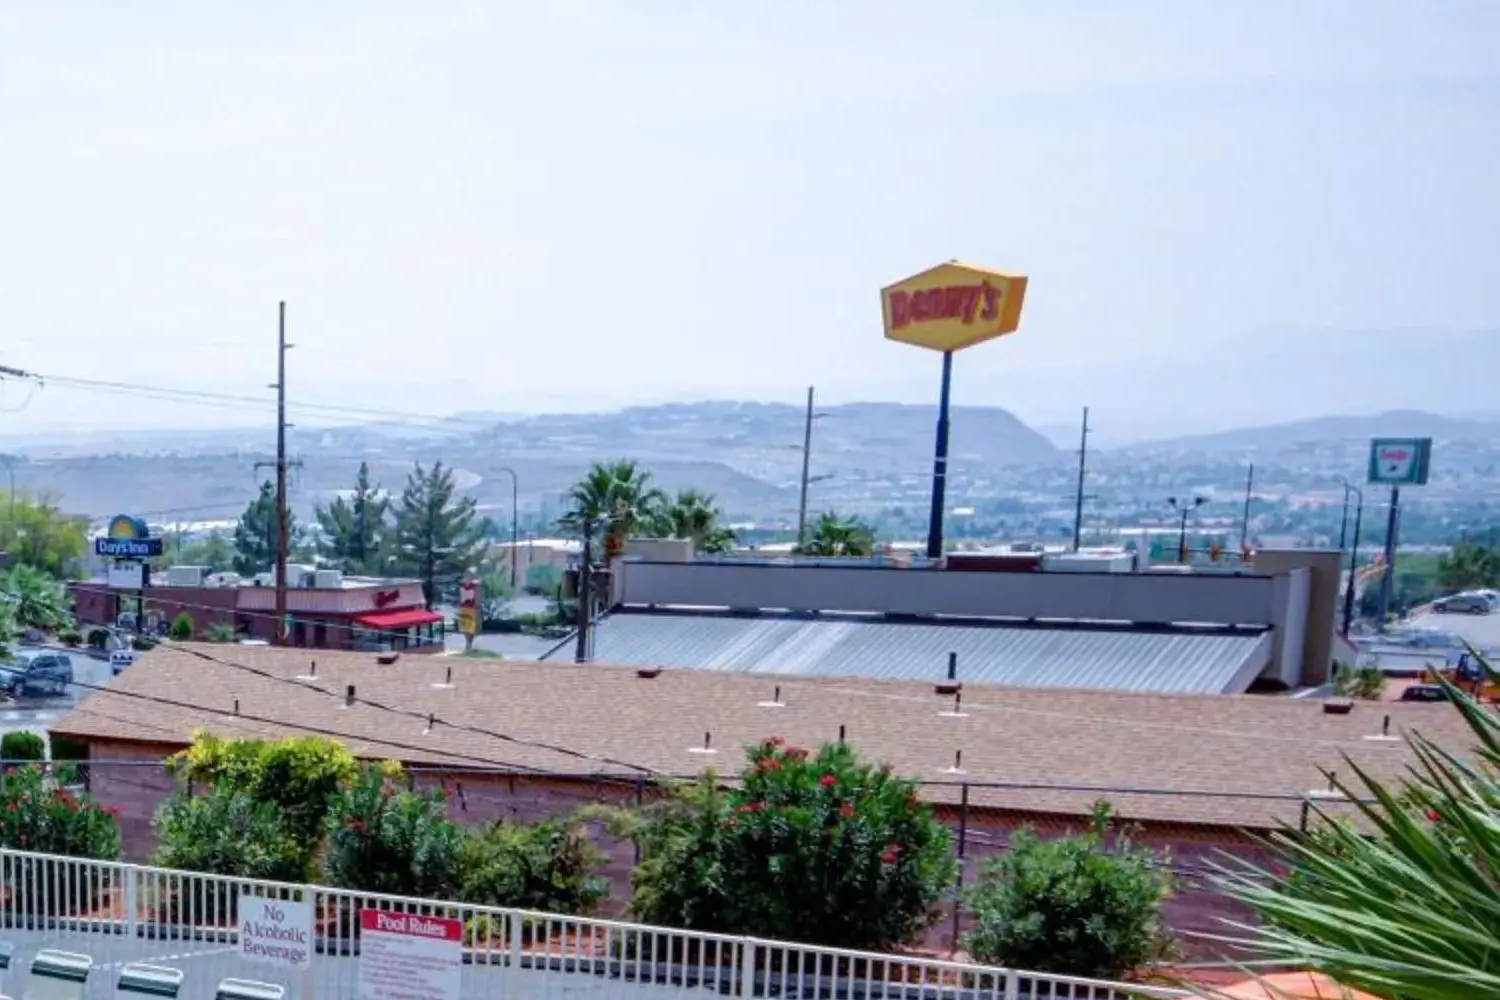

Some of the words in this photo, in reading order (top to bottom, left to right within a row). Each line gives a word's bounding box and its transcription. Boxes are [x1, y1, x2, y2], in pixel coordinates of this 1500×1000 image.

[99, 541, 128, 554] Days
[129, 541, 149, 554] Inn
[263, 904, 285, 923] No
[377, 913, 406, 931] Pool
[408, 917, 447, 937] Rules
[243, 920, 307, 944] Alcoholic
[243, 938, 307, 965] Beverage
